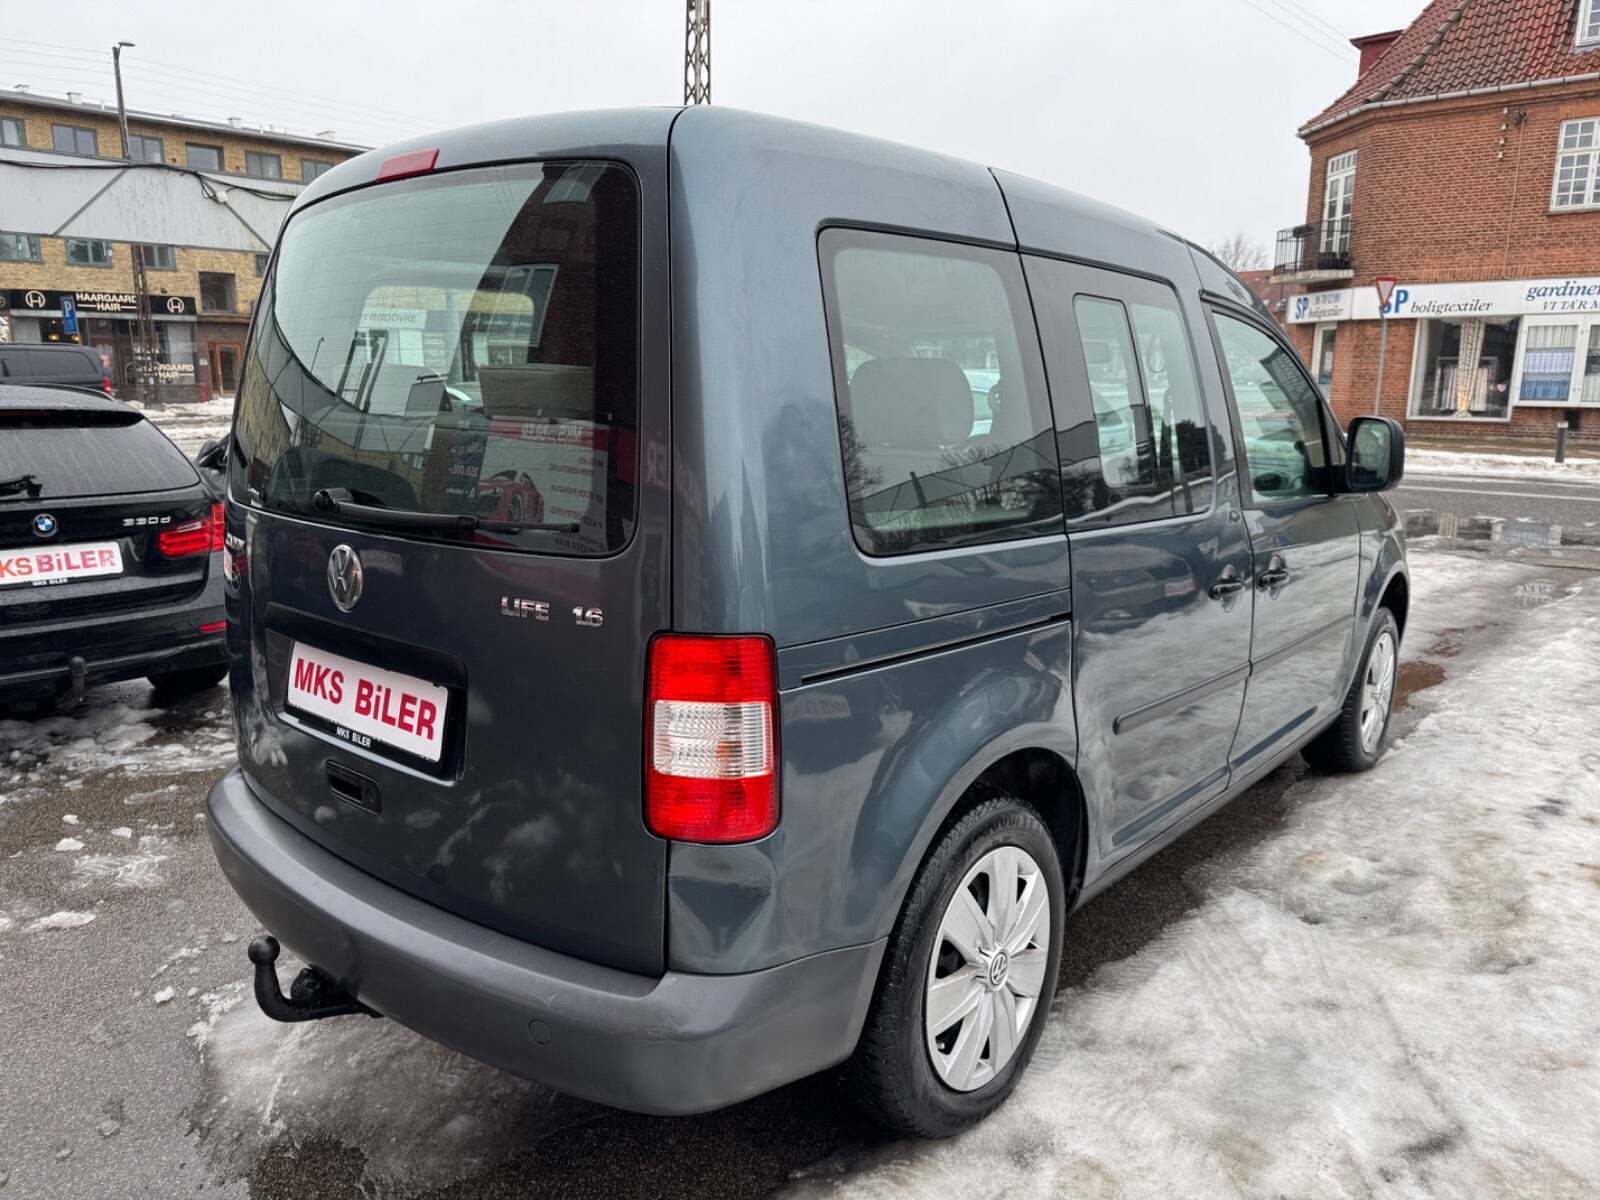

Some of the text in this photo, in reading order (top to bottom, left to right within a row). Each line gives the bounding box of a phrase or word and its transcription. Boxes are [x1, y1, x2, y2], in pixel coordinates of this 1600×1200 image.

[64, 301, 72, 317] P
[97, 302, 121, 312] HAIR
[1296, 297, 1309, 320] SP
[1410, 300, 1493, 315] boligtextiler
[35, 549, 116, 574] BiLER
[501, 596, 550, 622] LIFE
[294, 658, 437, 740] MKS BiLER
[336, 726, 350, 740] MKS
